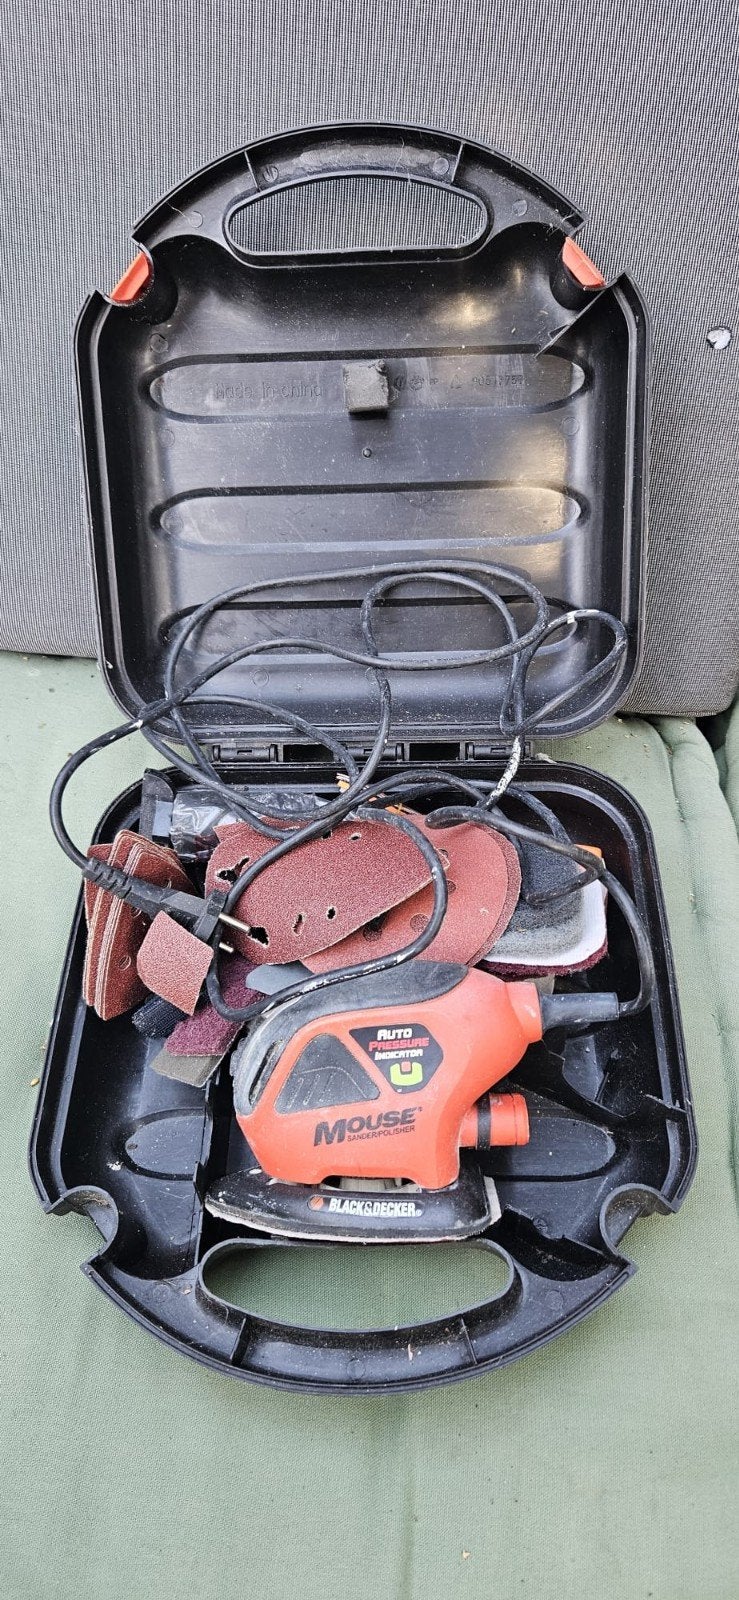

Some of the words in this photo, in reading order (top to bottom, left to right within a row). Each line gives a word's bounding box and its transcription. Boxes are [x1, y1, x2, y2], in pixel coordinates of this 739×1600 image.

[377, 1028, 413, 1041] AUTO
[368, 1037, 430, 1052] PRESSURE
[374, 1049, 424, 1061] INDICATOR
[347, 1125, 416, 1142] SANDER/POLISHER
